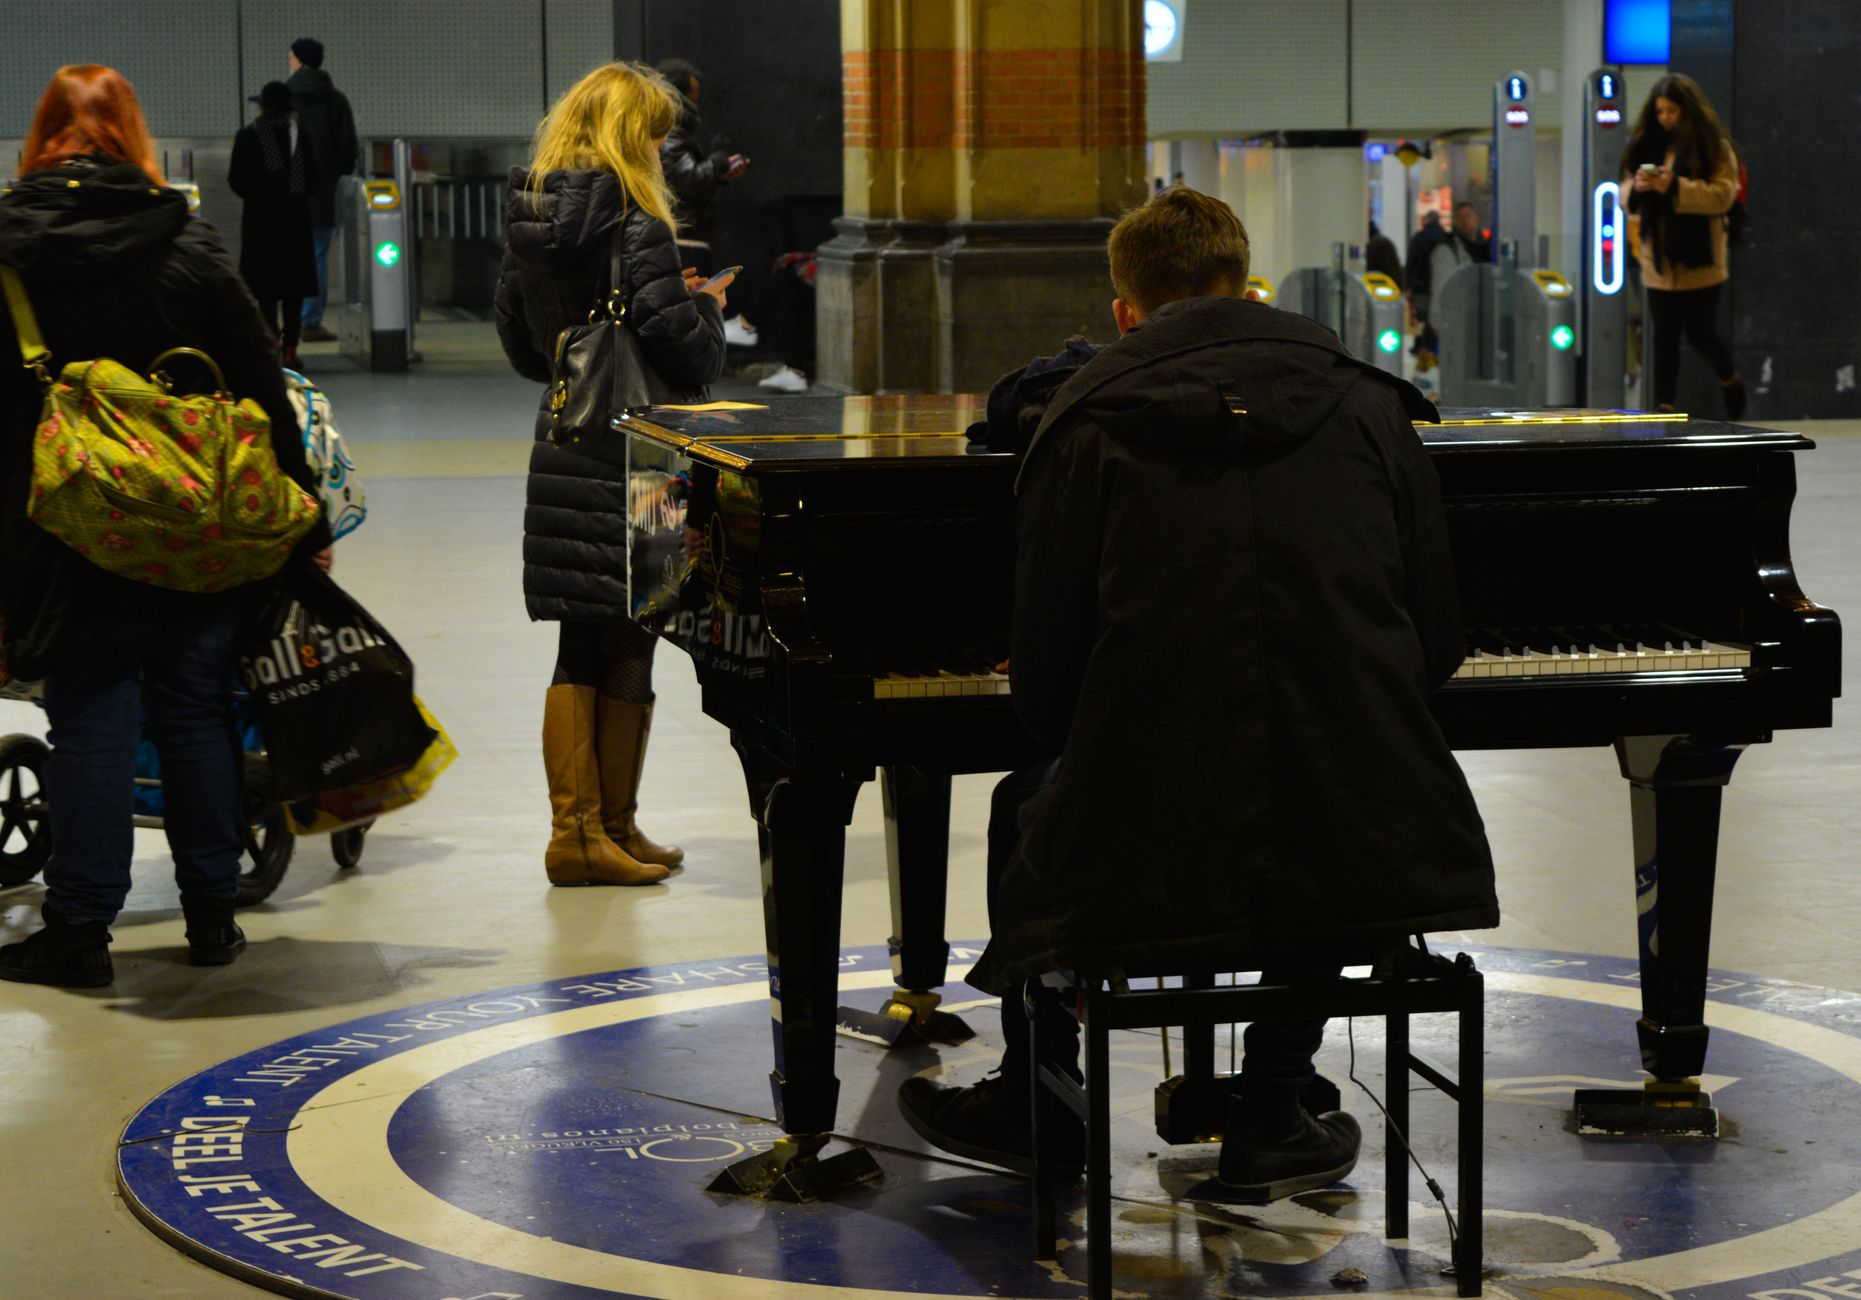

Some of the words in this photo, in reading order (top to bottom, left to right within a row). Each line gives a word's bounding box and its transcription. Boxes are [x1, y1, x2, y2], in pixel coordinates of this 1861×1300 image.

[267, 678, 321, 704] SINDS
[561, 962, 770, 998] SHARE
[385, 995, 572, 1031] YOUR
[233, 1032, 414, 1087] TALENT
[172, 1116, 251, 1170] DEEL
[177, 1174, 262, 1197] JE
[204, 1195, 426, 1278] TALENT
